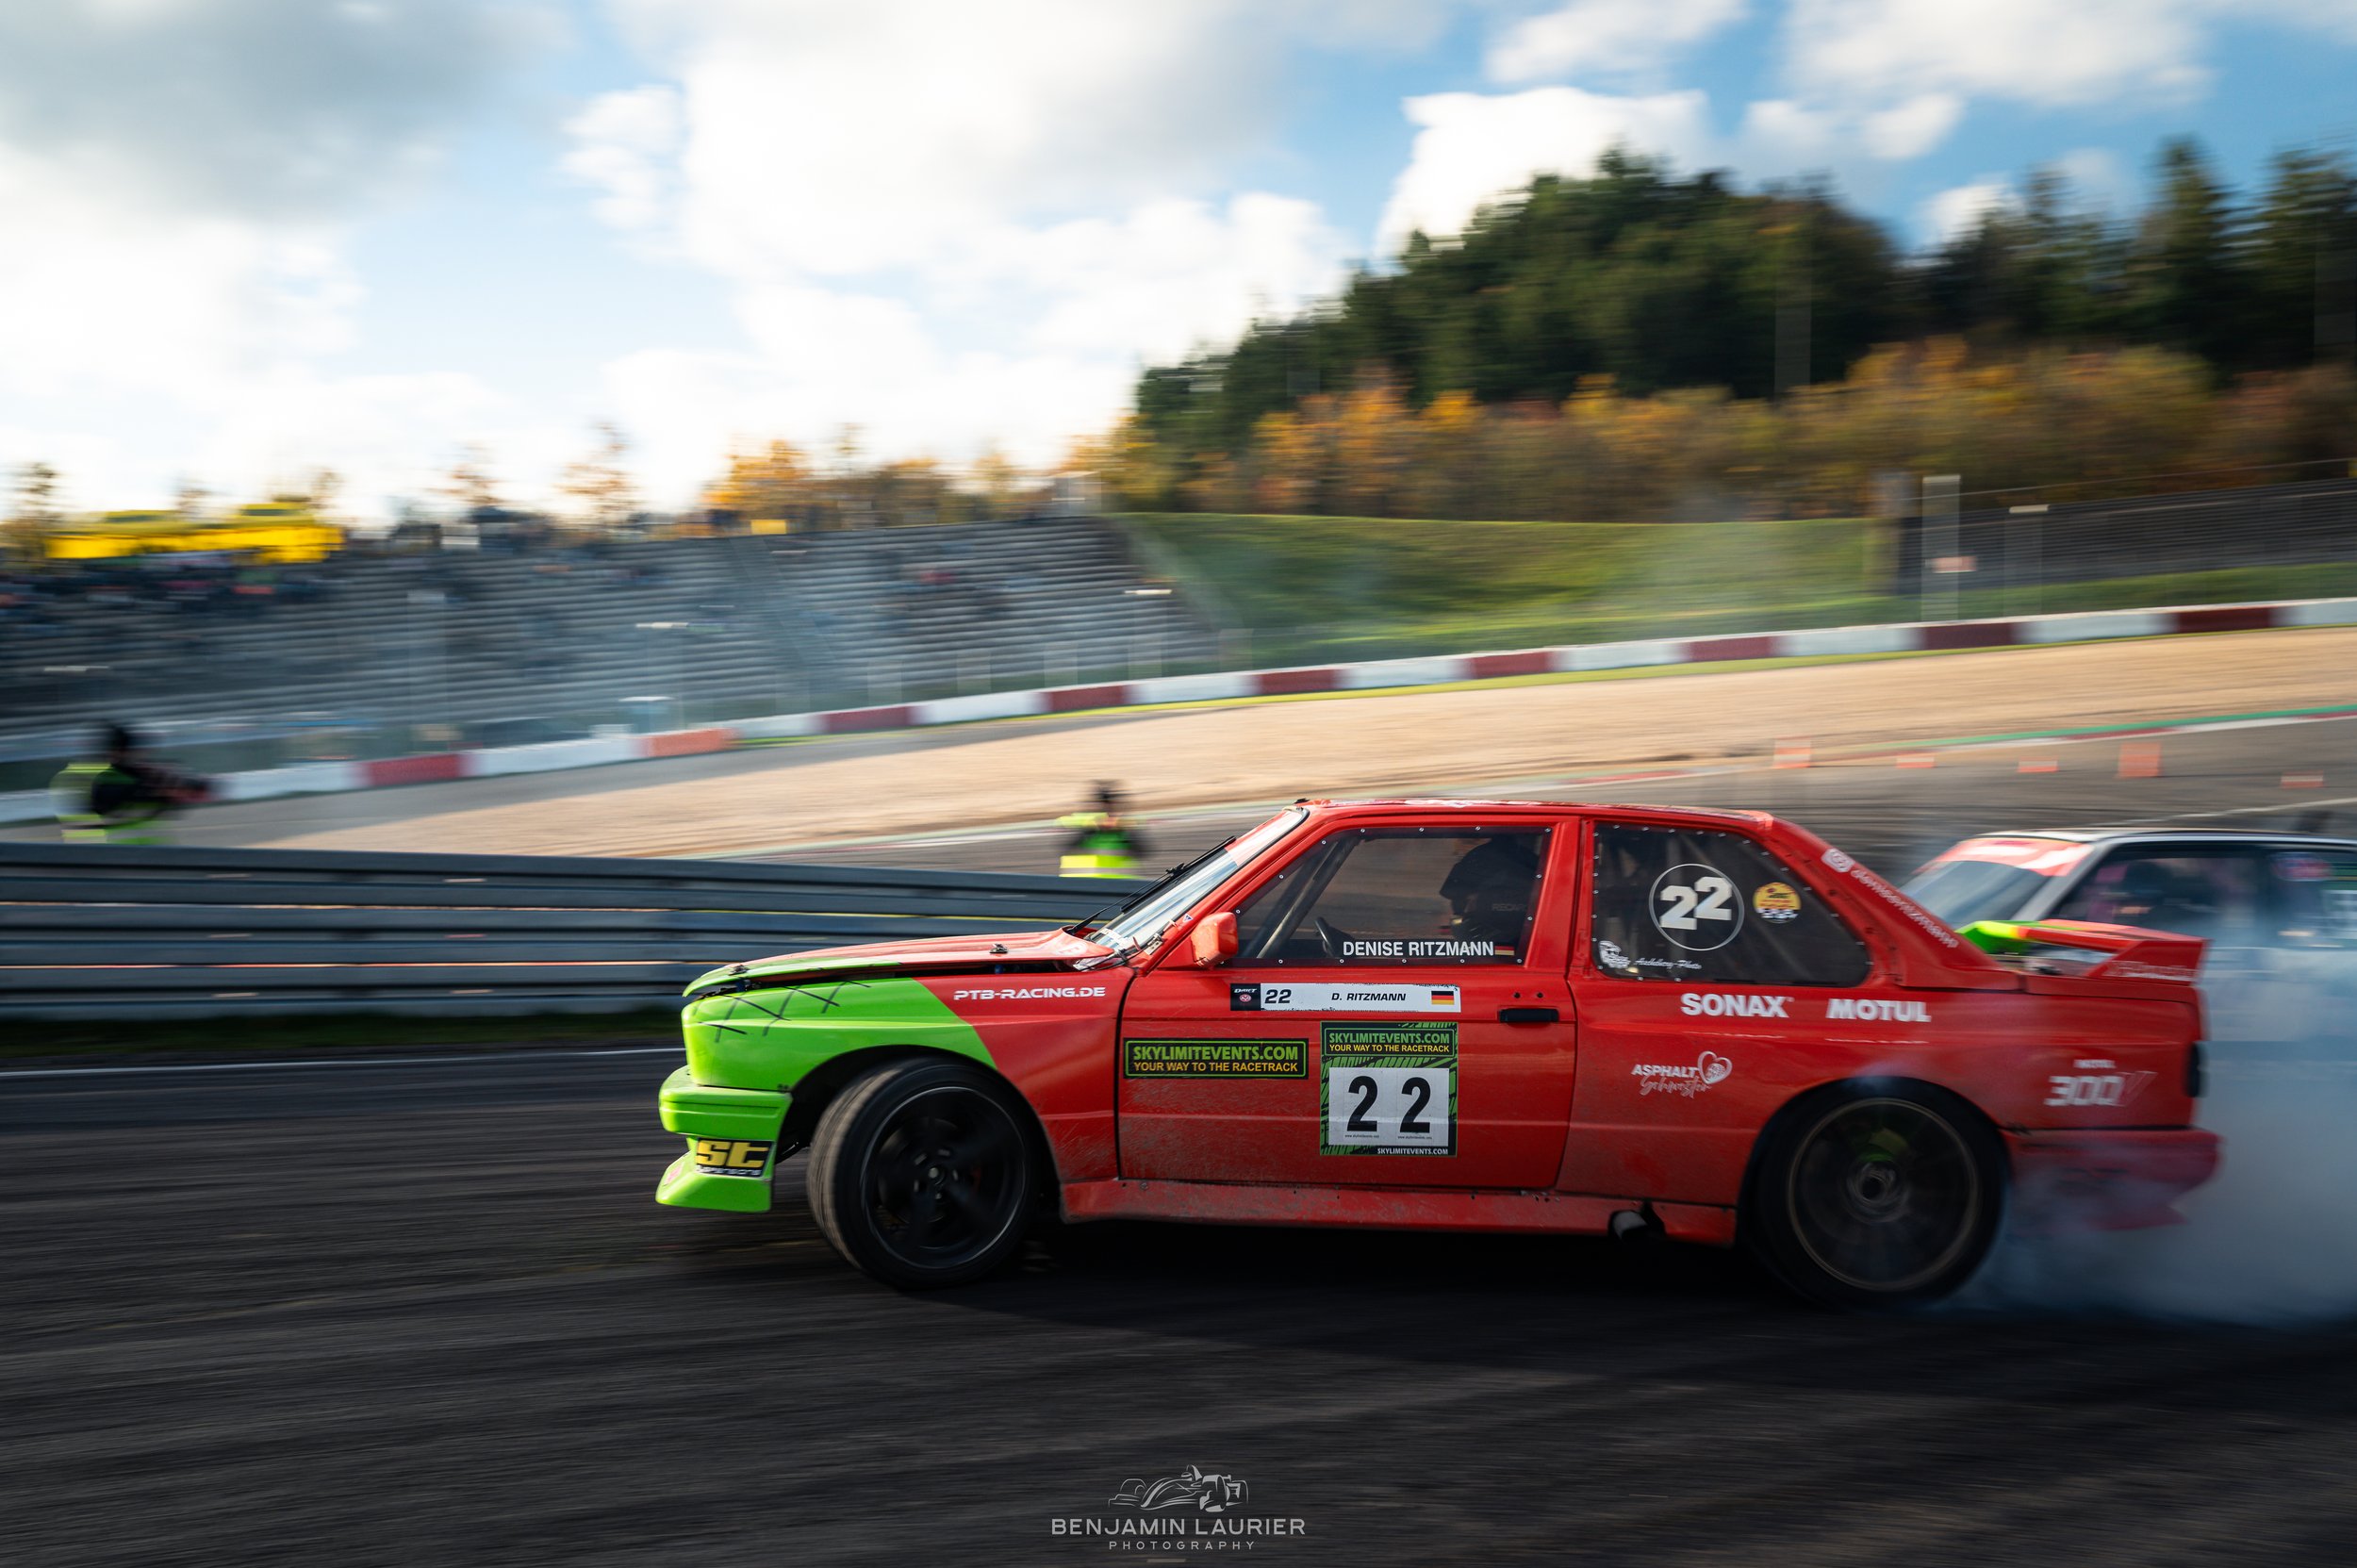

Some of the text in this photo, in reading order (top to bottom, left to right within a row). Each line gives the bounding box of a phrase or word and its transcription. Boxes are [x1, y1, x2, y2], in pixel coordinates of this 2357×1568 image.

[1658, 876, 1733, 931] 22
[1343, 941, 1494, 956] DENISE RITZMANN
[953, 986, 1107, 1000] PTB-RACING.DE
[1264, 989, 1407, 1004] 22 D. RITZMANN
[1680, 993, 1790, 1018] SONAX
[1825, 999, 1932, 1022] MOTUL
[1328, 1032, 1450, 1044] SKYLIMITEVENTS.COM
[1133, 1046, 1298, 1061] SKYLIMITEVENTS.COM
[1329, 1044, 1450, 1053] YOUR WAY TO THE RACETRACK
[1133, 1062, 1298, 1072] YOUR WAY TO THE RACETRACK
[1631, 1064, 1701, 1078] ASPHALT
[1376, 1147, 1449, 1156] SKYLIMITEVENTS.COM
